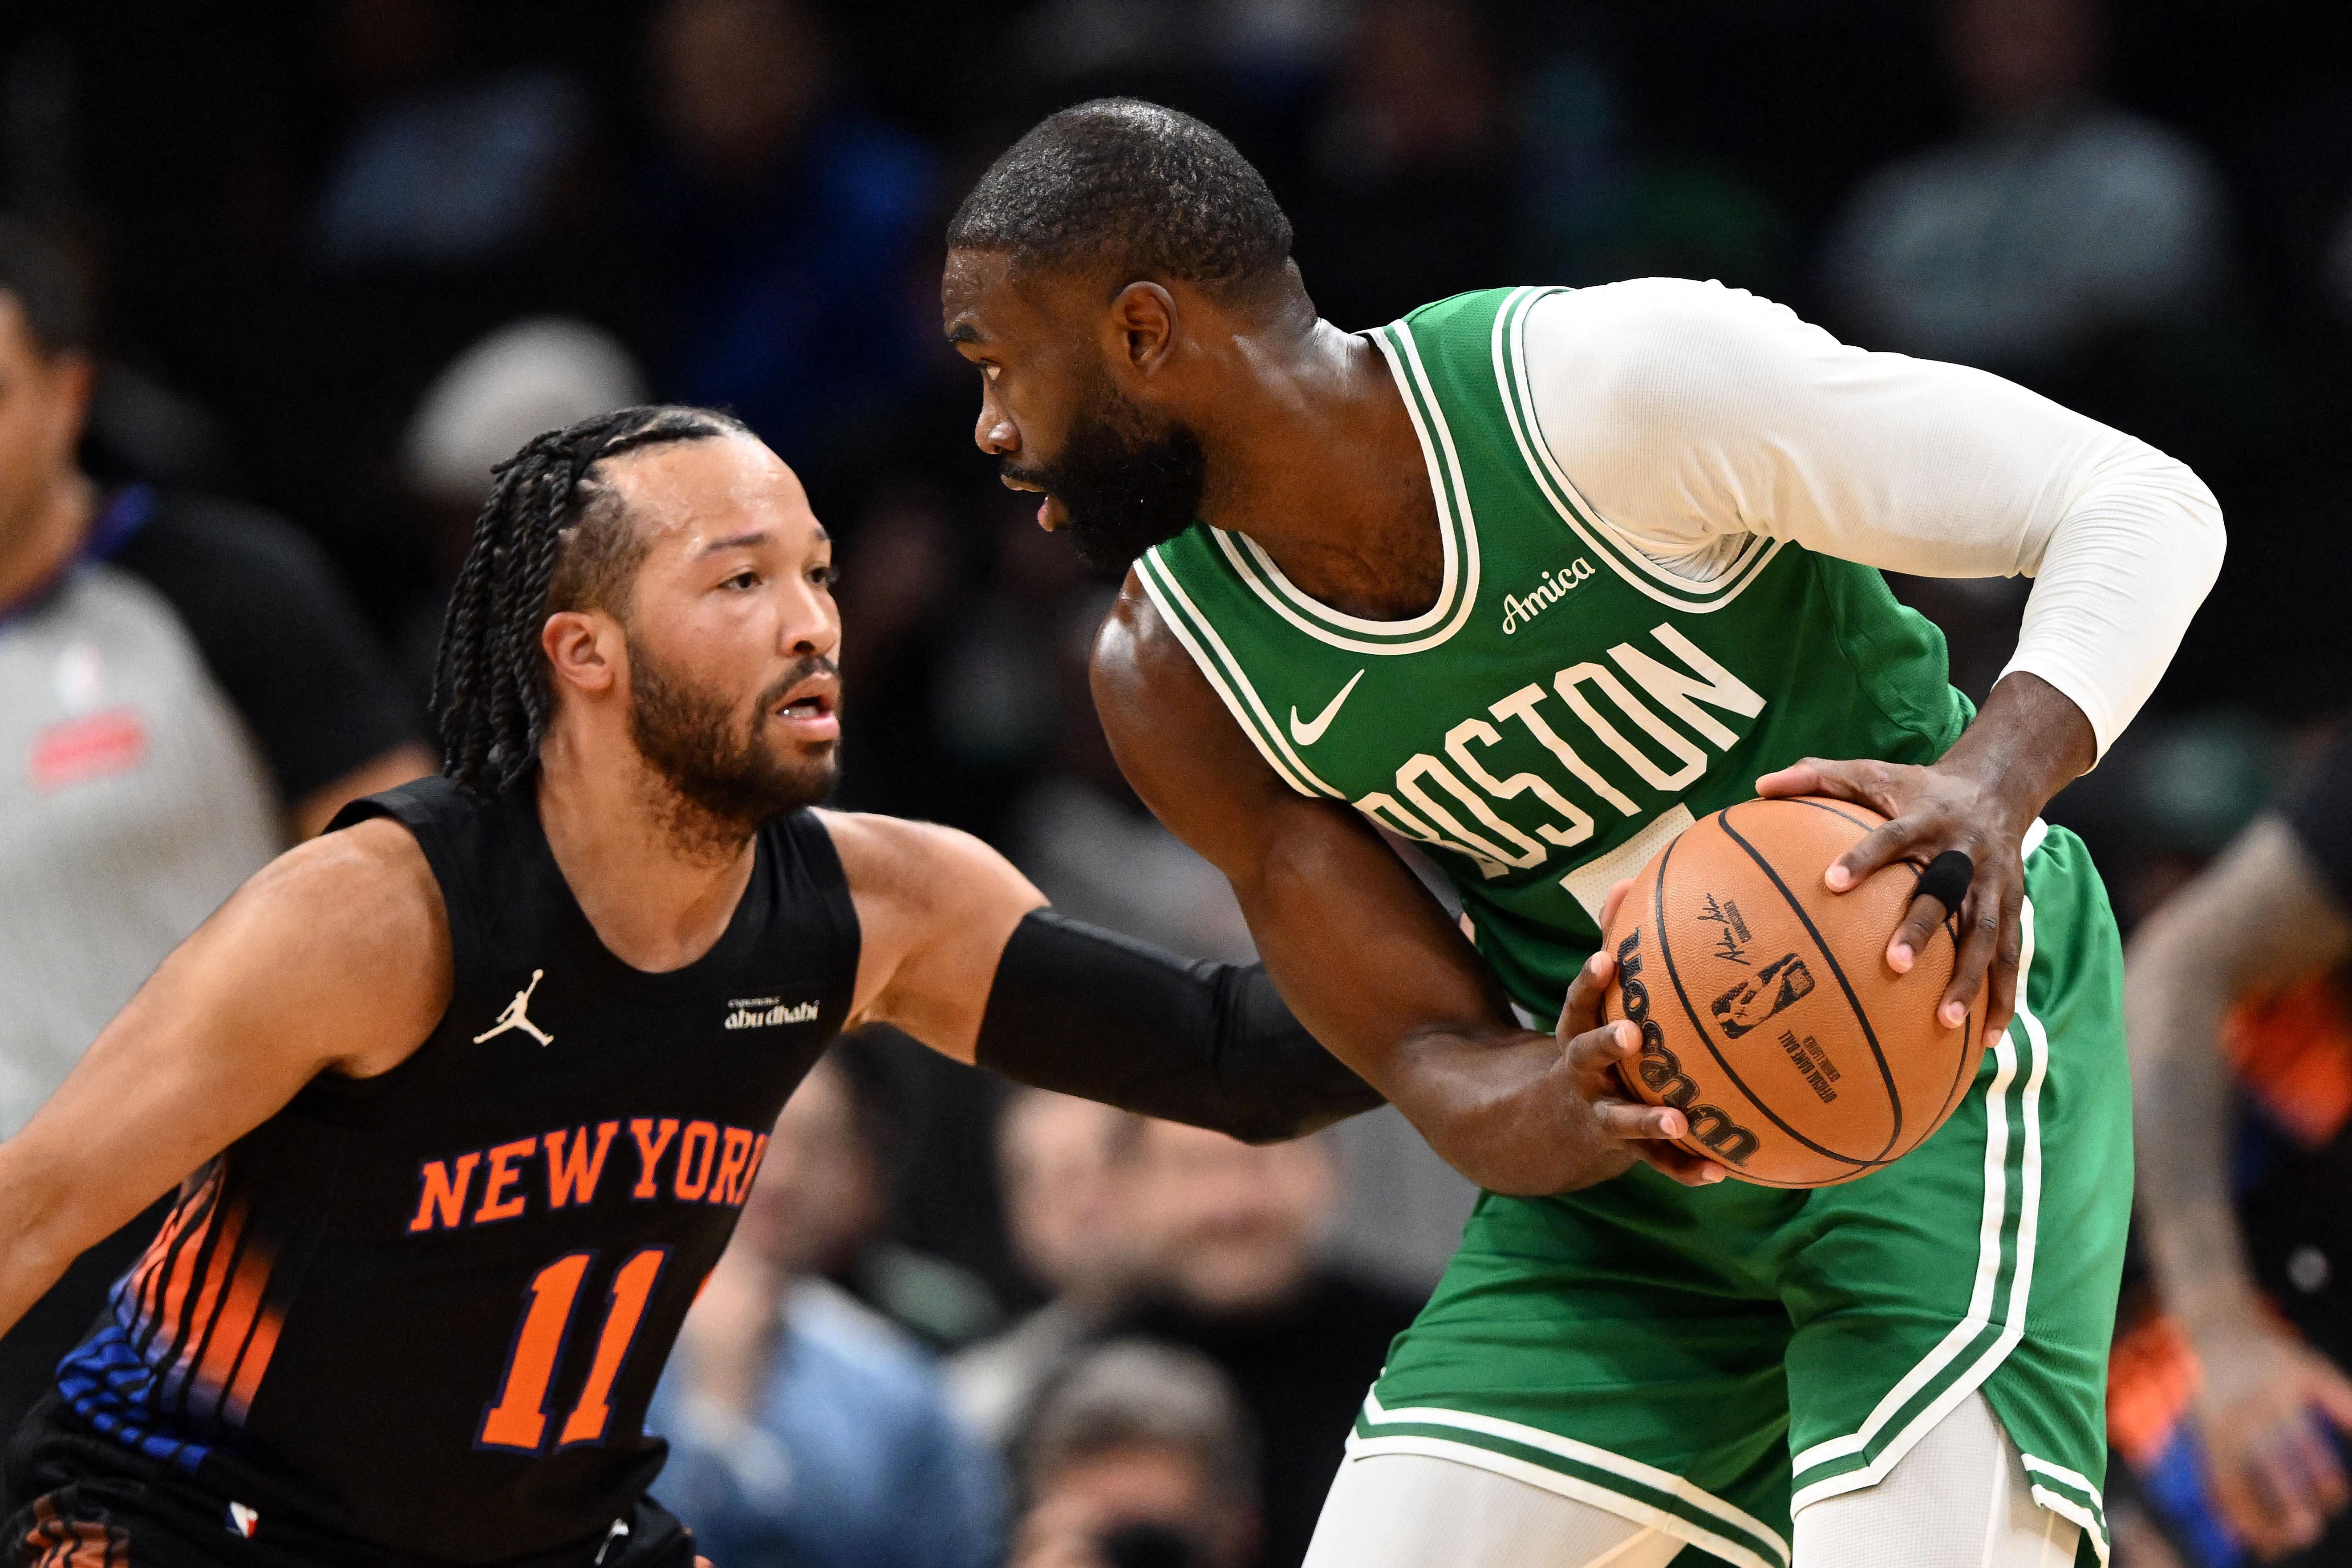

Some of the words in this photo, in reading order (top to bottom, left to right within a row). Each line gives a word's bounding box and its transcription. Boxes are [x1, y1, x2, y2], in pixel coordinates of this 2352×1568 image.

[1503, 557, 1596, 635] Amica
[407, 1119, 620, 1233] NEW
[473, 1245, 672, 1456] 11
